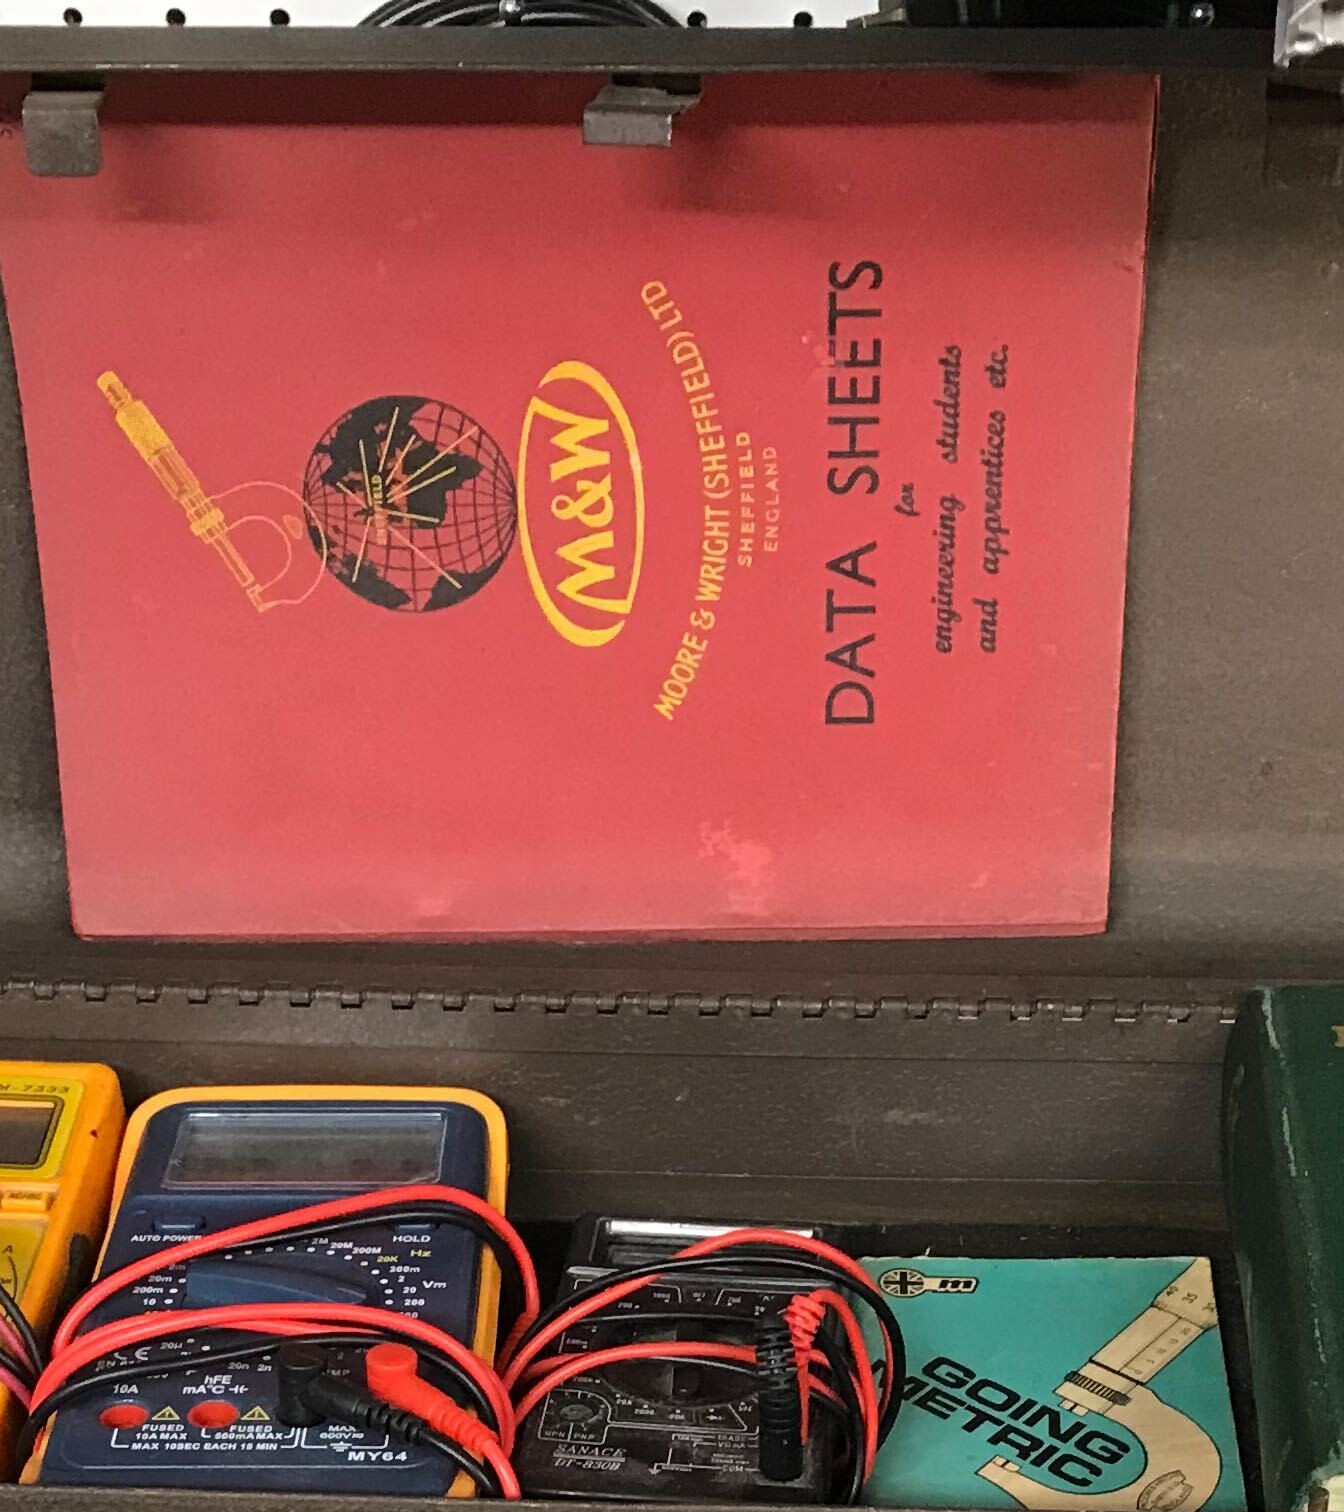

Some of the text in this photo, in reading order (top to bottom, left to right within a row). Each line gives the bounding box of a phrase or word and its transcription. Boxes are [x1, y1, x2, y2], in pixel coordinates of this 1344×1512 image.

[554, 402, 620, 612] M&W
[641, 281, 734, 720] MOORE & WRIGHT (SHEFFIELD) LTD
[734, 430, 753, 567] SHEFFIELD
[762, 445, 779, 552] ENGLAND
[823, 260, 884, 725] DATA SHEETS
[894, 481, 918, 519] for
[934, 344, 964, 654] engineering students
[973, 343, 1009, 653] and apprentices etc.
[393, 1235, 431, 1243] HOLD
[1182, 1292, 1198, 1304] 35
[113, 1385, 139, 1393] 10A
[205, 1375, 232, 1385] hFE
[228, 1362, 249, 1370] 20n
[922, 1357, 1130, 1465] GOING
[348, 1452, 407, 1461] MY64
